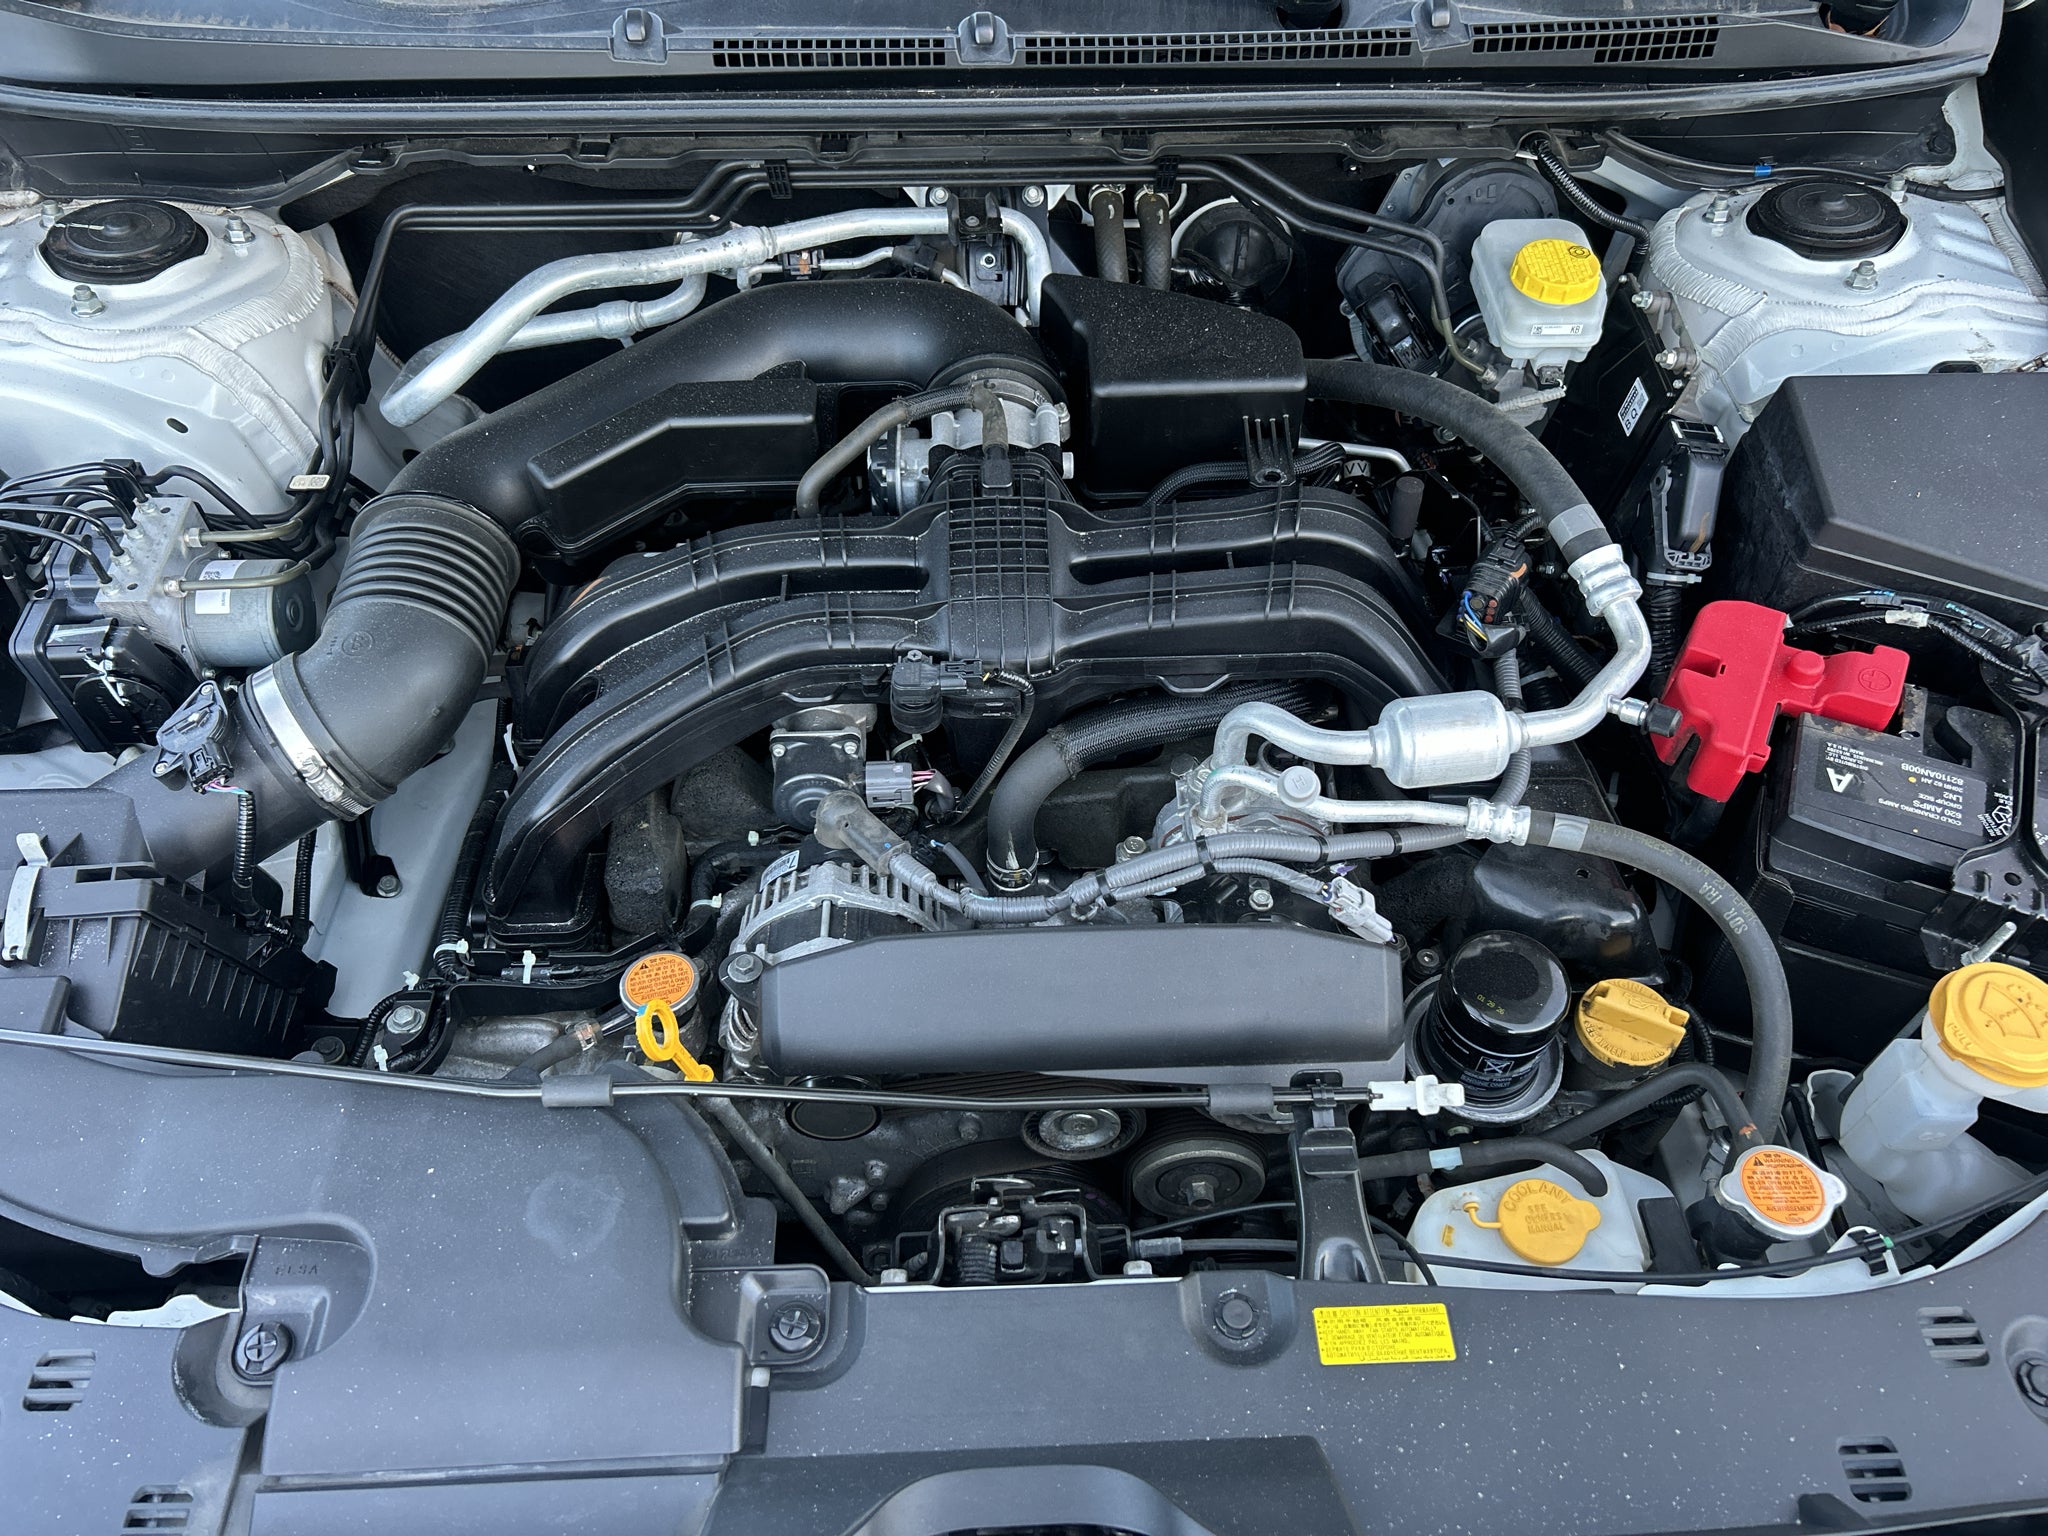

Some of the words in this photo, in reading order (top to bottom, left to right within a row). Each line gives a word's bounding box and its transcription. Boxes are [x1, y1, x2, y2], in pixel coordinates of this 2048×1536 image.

[1943, 791, 1963, 803] LN2
[1912, 799, 1943, 814] AMPS
[1944, 808, 1962, 819] 620
[1503, 1181, 1573, 1212] COOLANT
